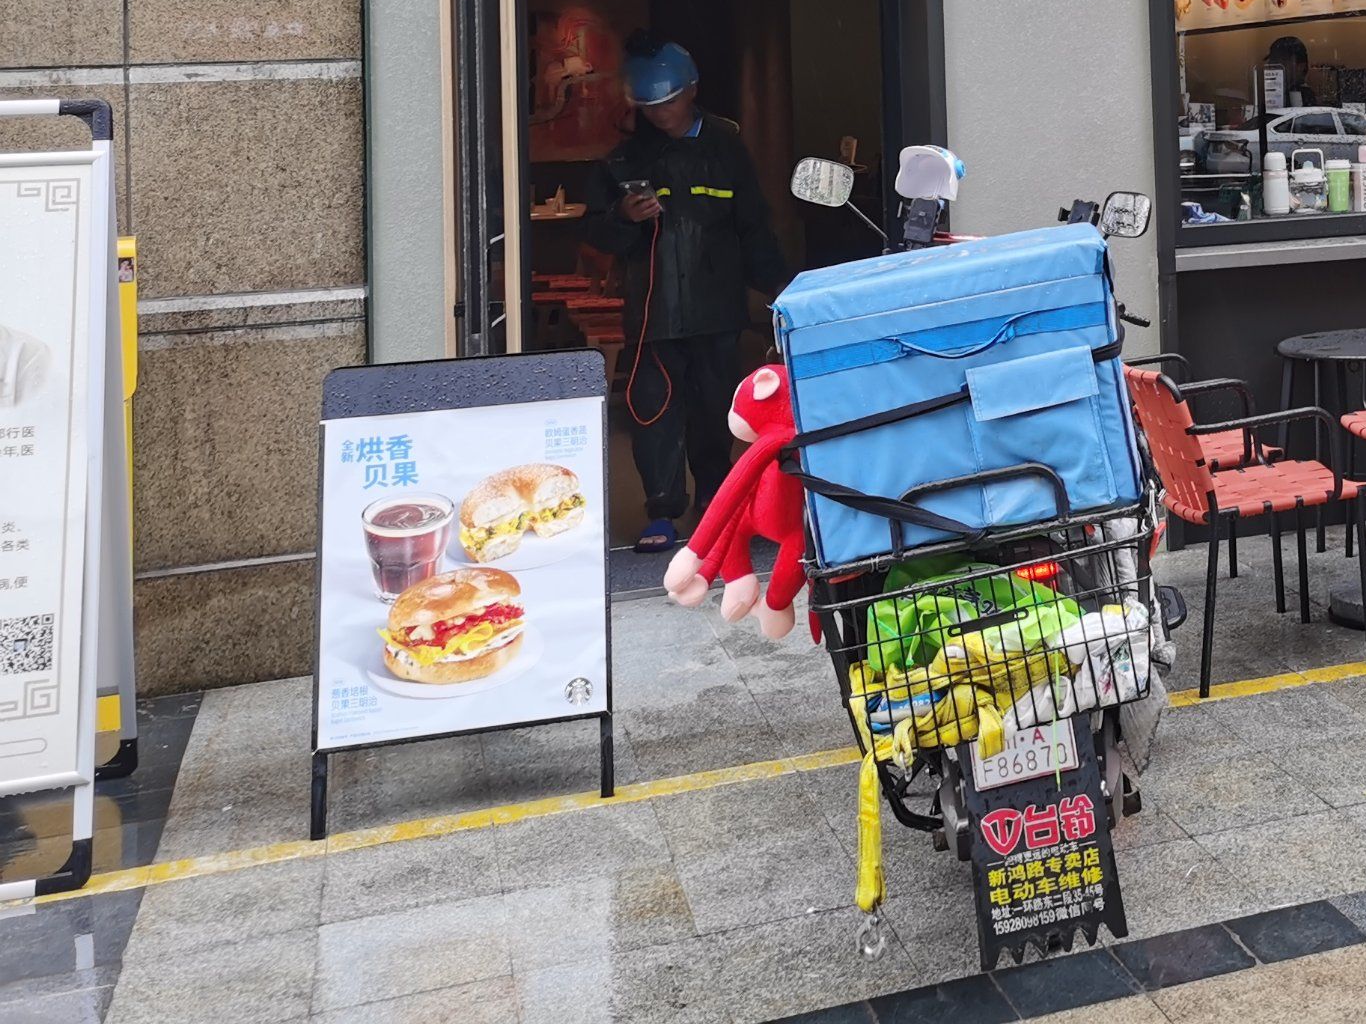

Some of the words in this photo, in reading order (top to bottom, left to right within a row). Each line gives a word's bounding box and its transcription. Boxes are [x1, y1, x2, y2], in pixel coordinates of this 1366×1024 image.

[356, 434, 413, 463] 烘香
[362, 461, 419, 490] 贝果
[982, 742, 1069, 783] F86870
[1024, 794, 1096, 849] 台铃
[987, 847, 1101, 888] 新鸿路专卖店
[989, 866, 1104, 906] 电动车维修
